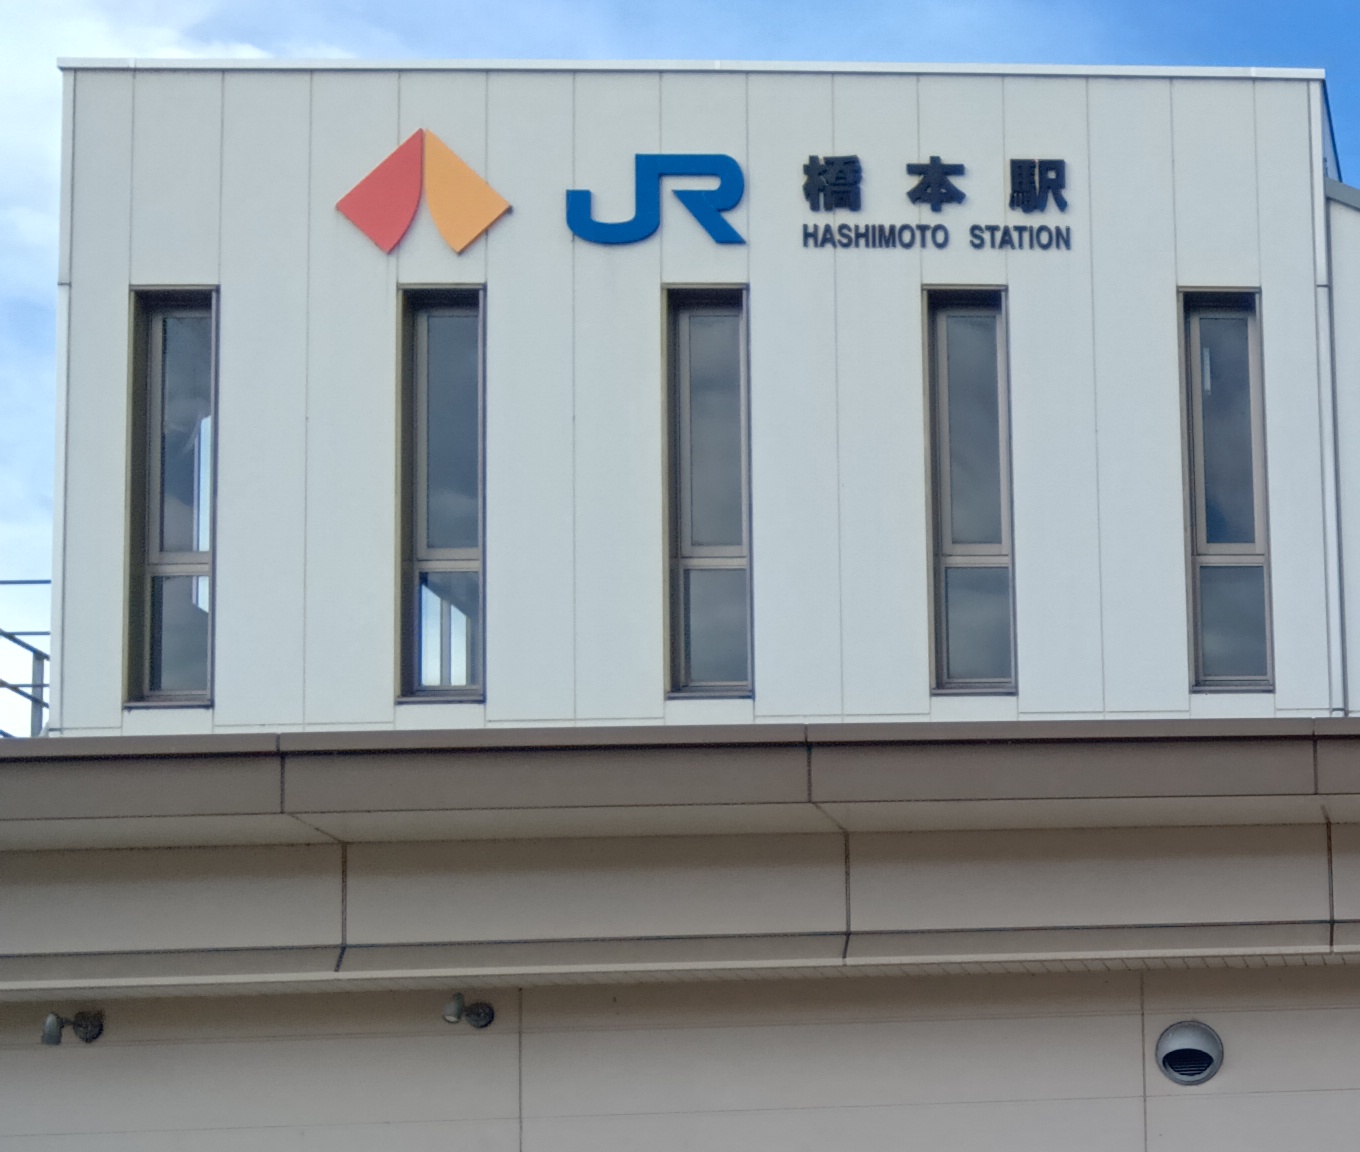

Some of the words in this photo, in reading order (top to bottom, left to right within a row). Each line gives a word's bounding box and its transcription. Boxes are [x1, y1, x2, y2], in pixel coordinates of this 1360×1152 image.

[566, 154, 746, 244] JR
[802, 155, 1067, 212] 橋本駅
[802, 224, 949, 249] HASHIMOTO
[969, 224, 1071, 250] STATION
